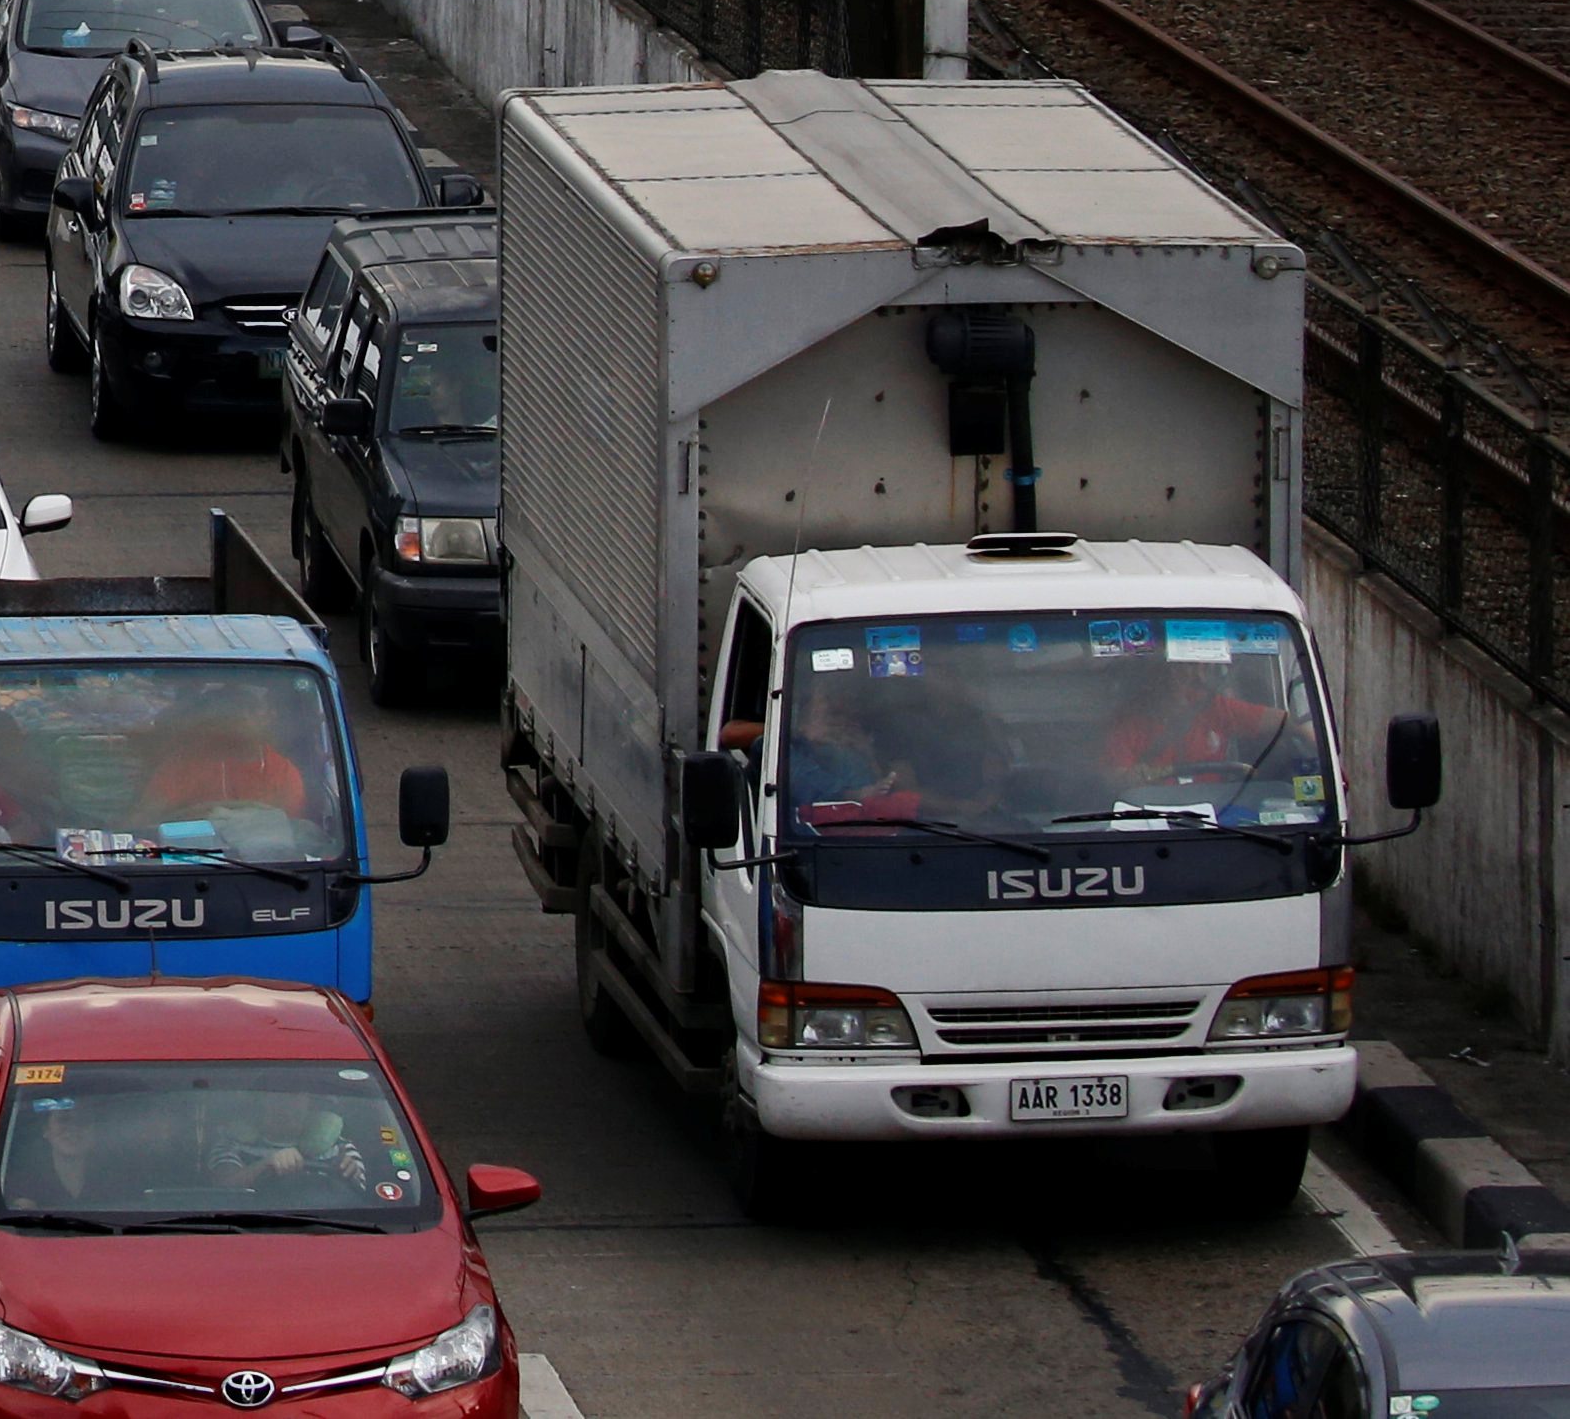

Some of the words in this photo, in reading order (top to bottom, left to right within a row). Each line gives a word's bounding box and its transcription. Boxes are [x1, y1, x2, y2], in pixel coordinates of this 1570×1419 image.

[987, 865, 1146, 900] ISUZU
[44, 897, 205, 930] ISUZU
[251, 905, 311, 922] ELF
[1018, 1085, 1058, 1110] AAR
[1069, 1083, 1122, 1107] 1338
